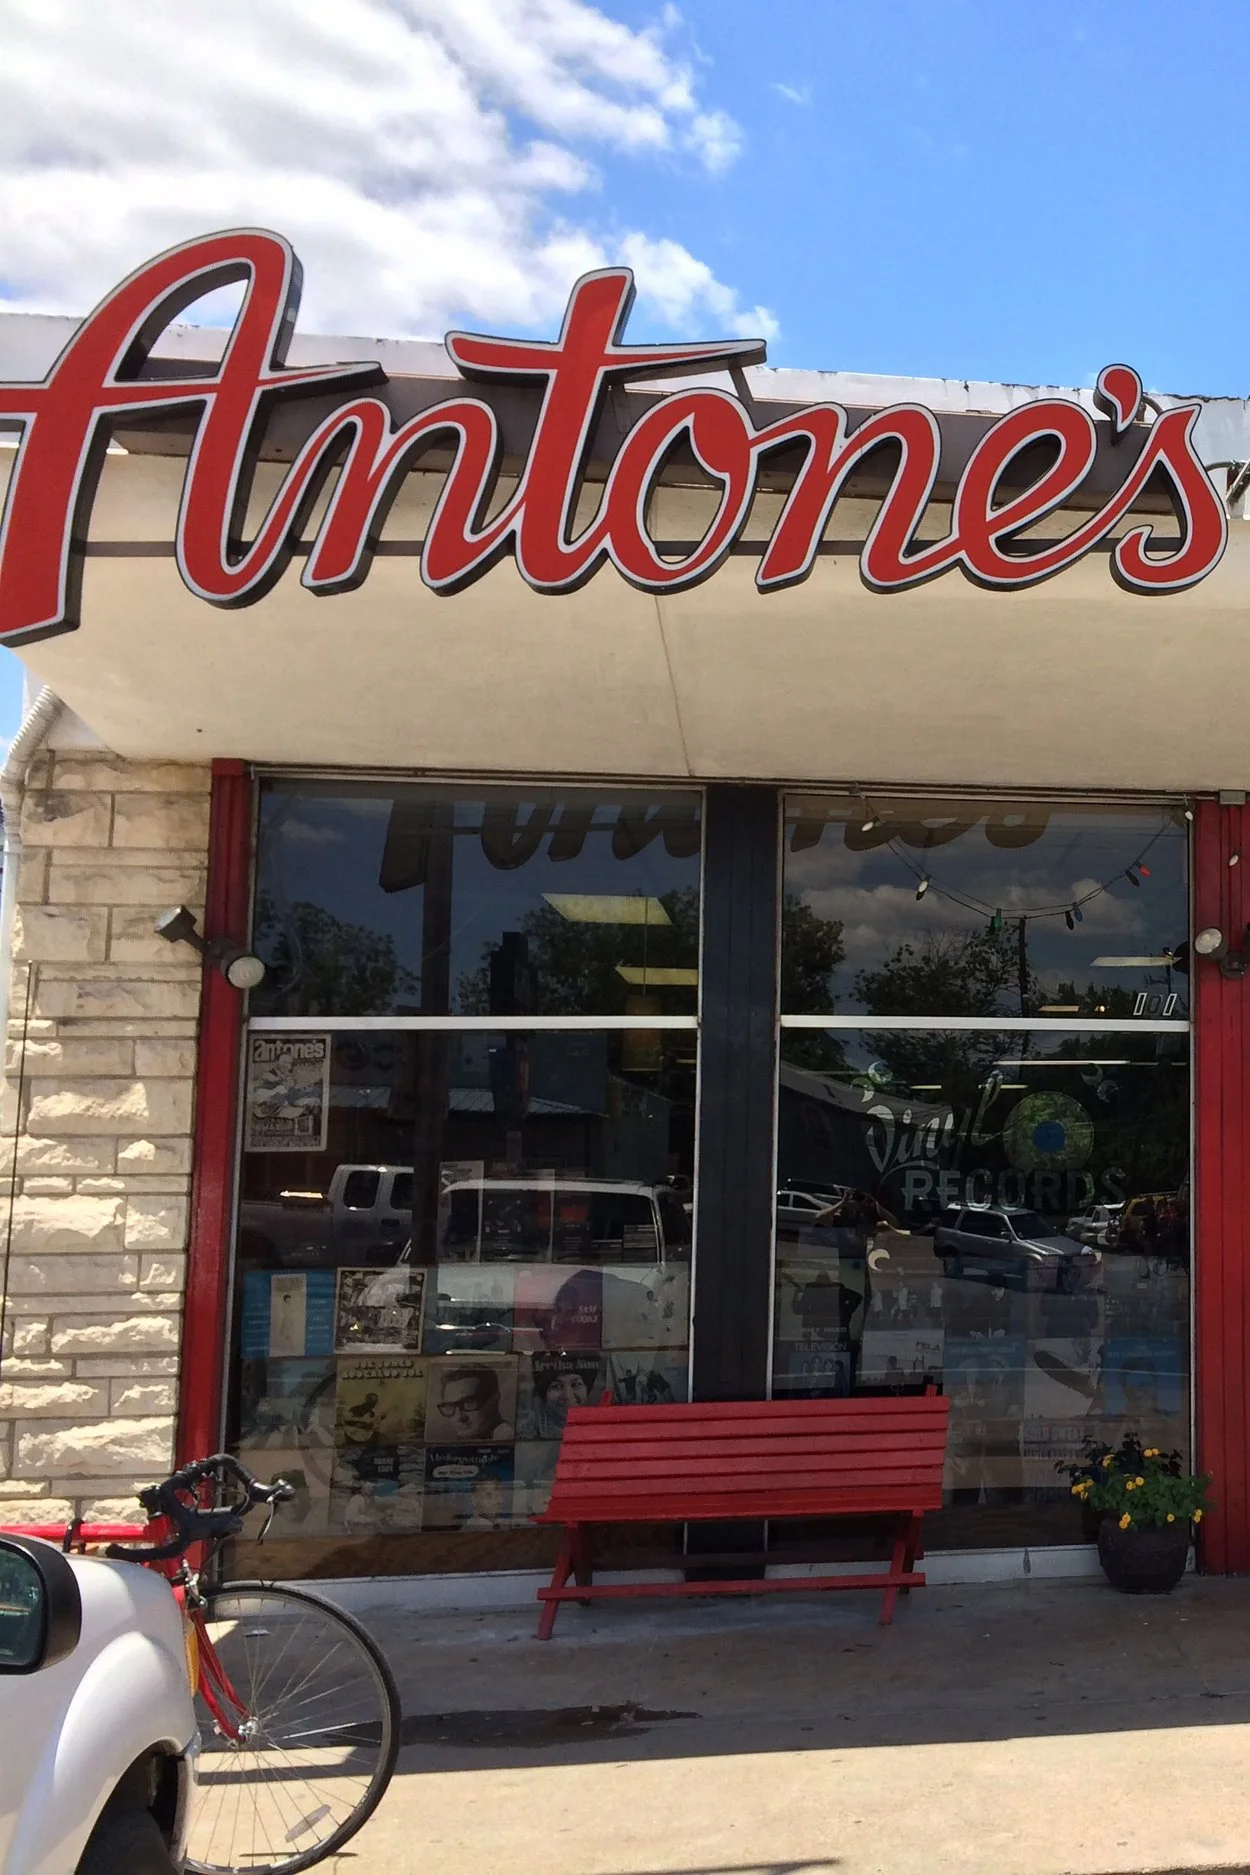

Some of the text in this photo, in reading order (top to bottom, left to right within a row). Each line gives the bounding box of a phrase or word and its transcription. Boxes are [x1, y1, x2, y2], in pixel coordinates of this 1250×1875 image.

[0, 227, 1230, 644] Antone's
[866, 1069, 1013, 1180] Vinyl
[901, 1167, 1127, 1211] RECORDS
